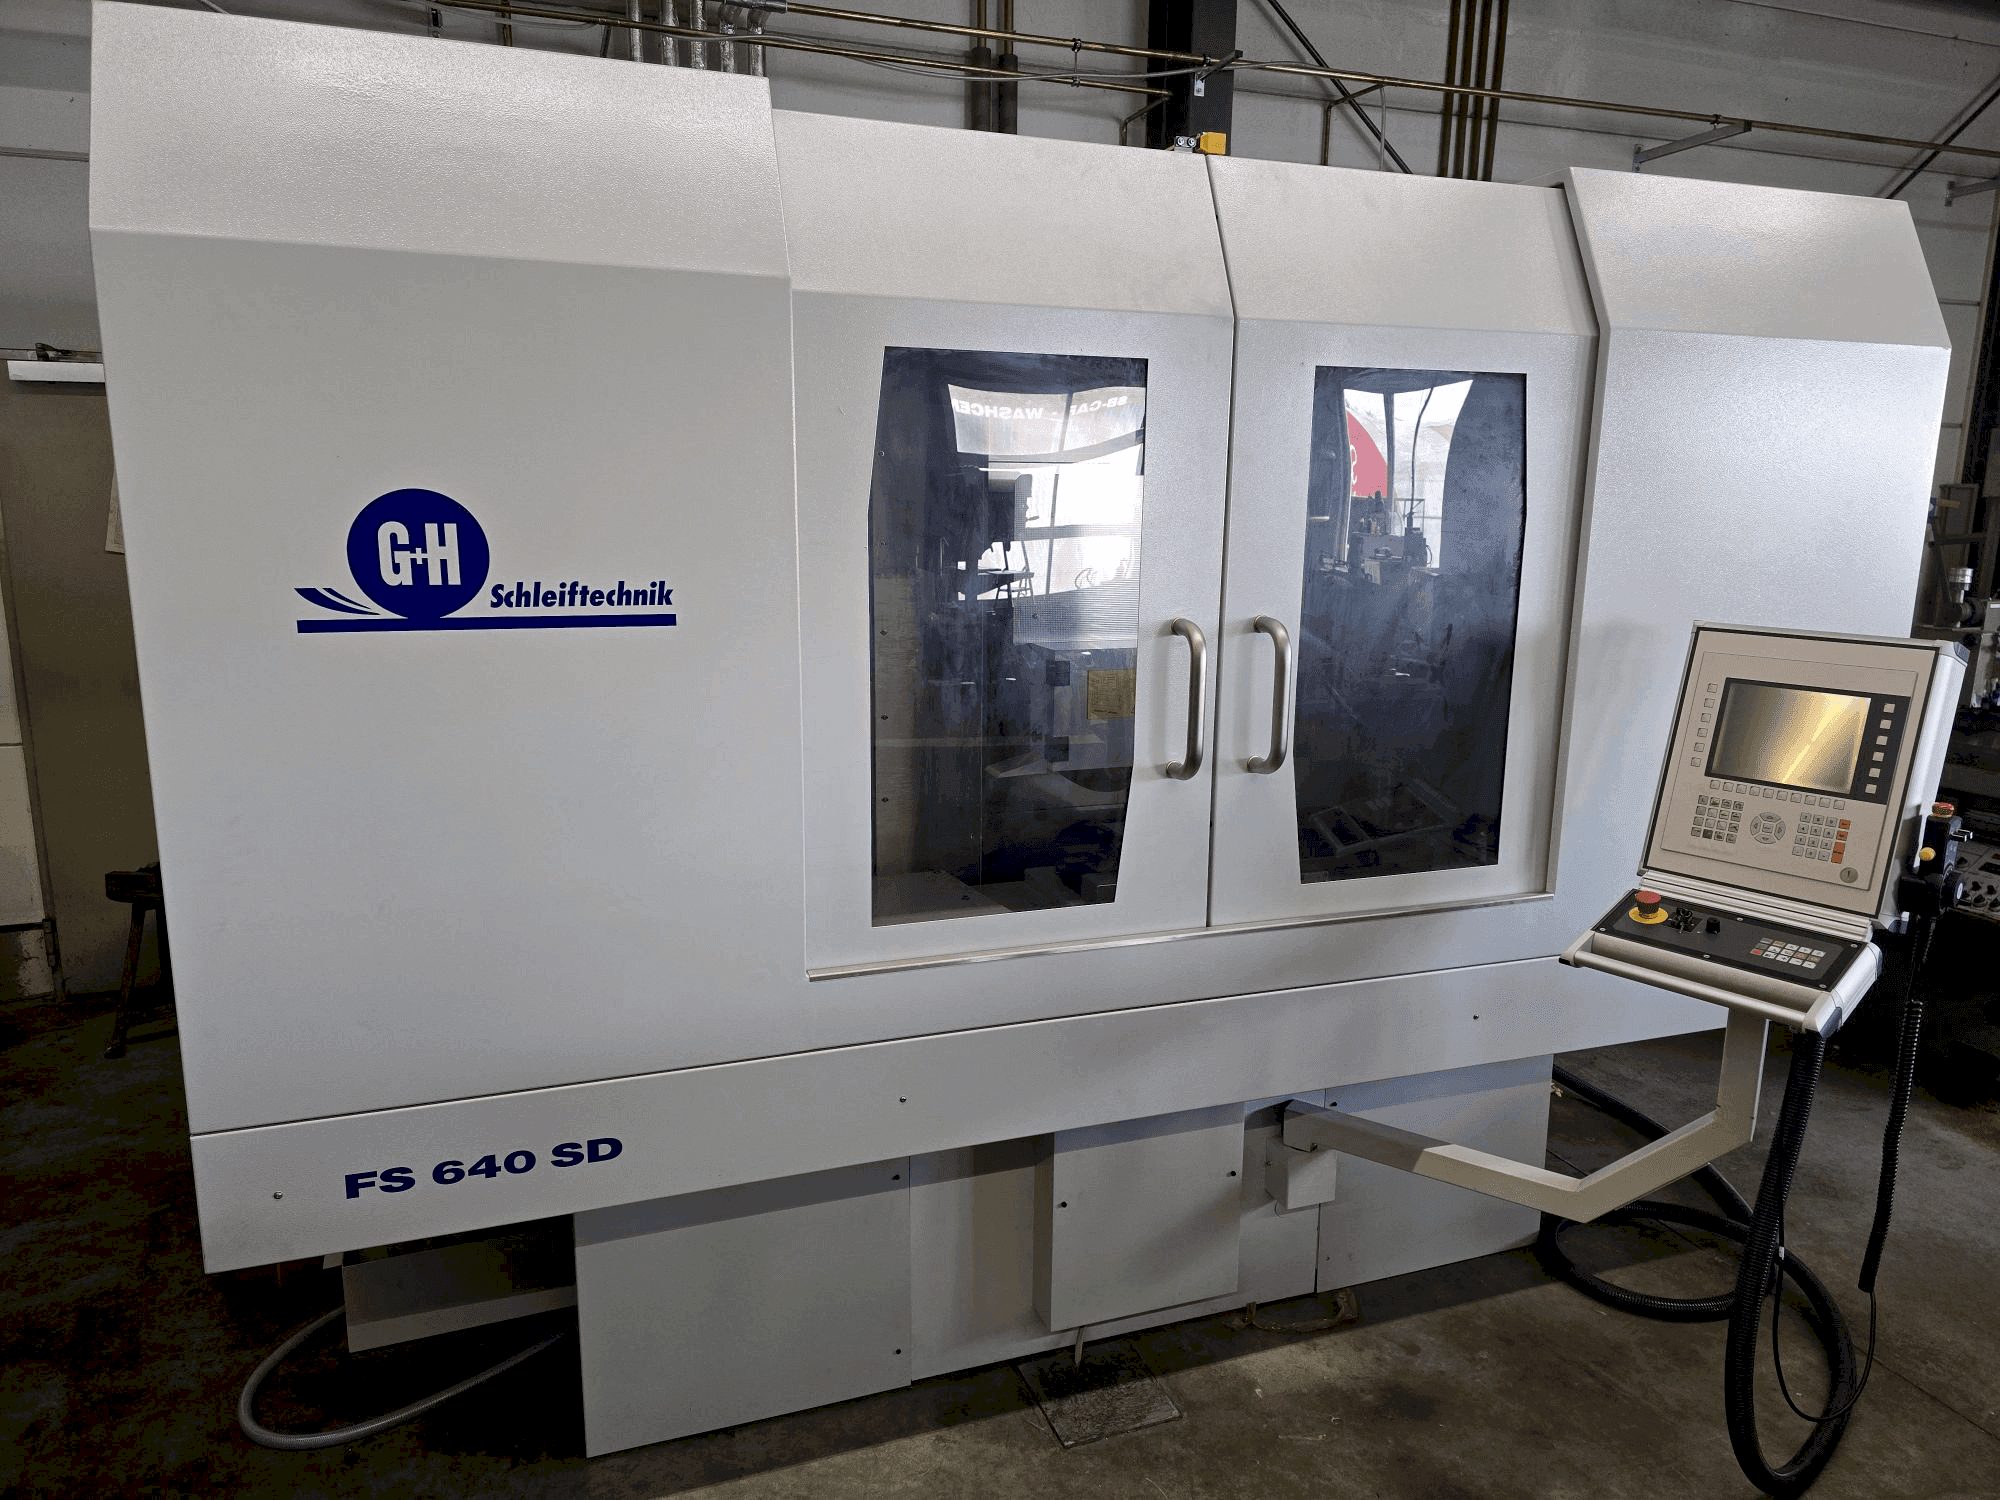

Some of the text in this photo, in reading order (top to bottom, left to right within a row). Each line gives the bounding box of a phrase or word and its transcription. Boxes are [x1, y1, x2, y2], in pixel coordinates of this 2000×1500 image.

[377, 520, 461, 586] G+H
[490, 581, 673, 608] Schleiftechnik
[344, 1137, 623, 1199] FS 640 SD
